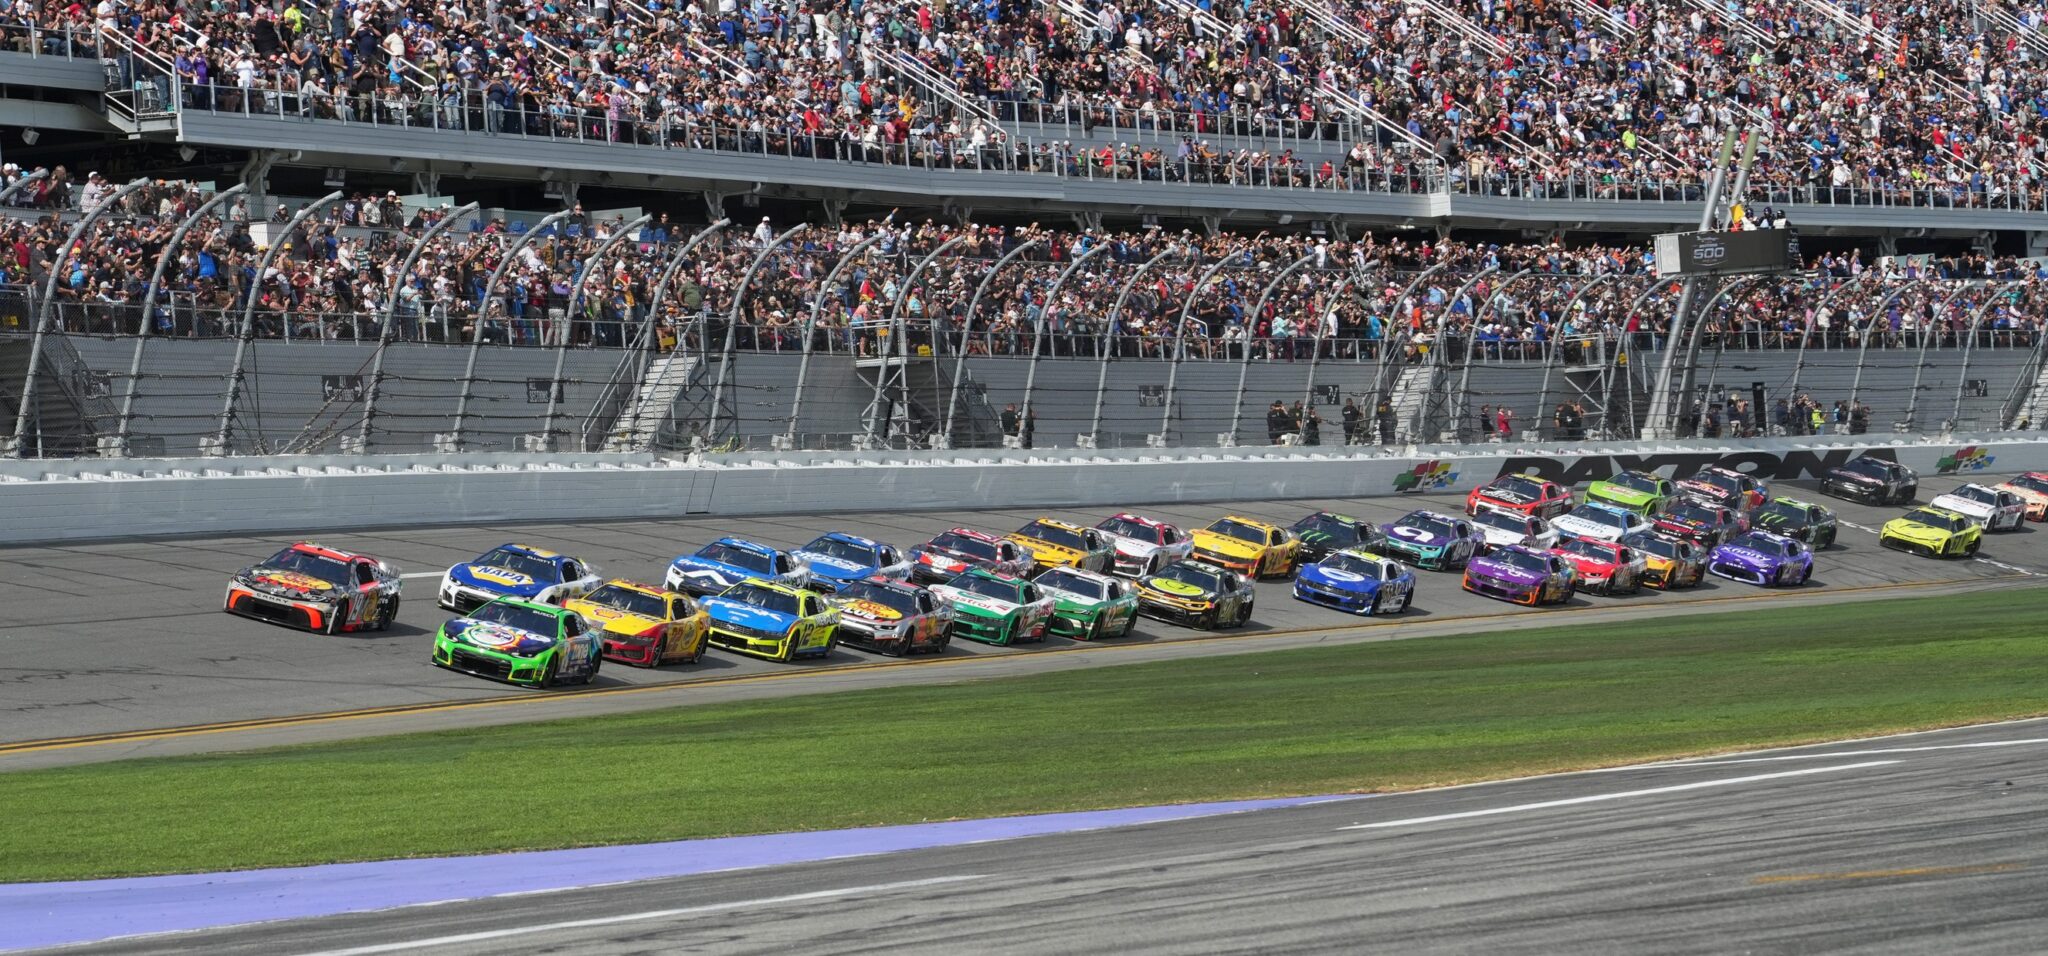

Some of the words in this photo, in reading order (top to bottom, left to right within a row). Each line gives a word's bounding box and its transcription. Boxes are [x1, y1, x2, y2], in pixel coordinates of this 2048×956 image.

[1693, 247, 1725, 259] 500
[477, 565, 526, 583] NAPA
[256, 591, 289, 604] CAMRY
[532, 609, 557, 620] BUSCH
